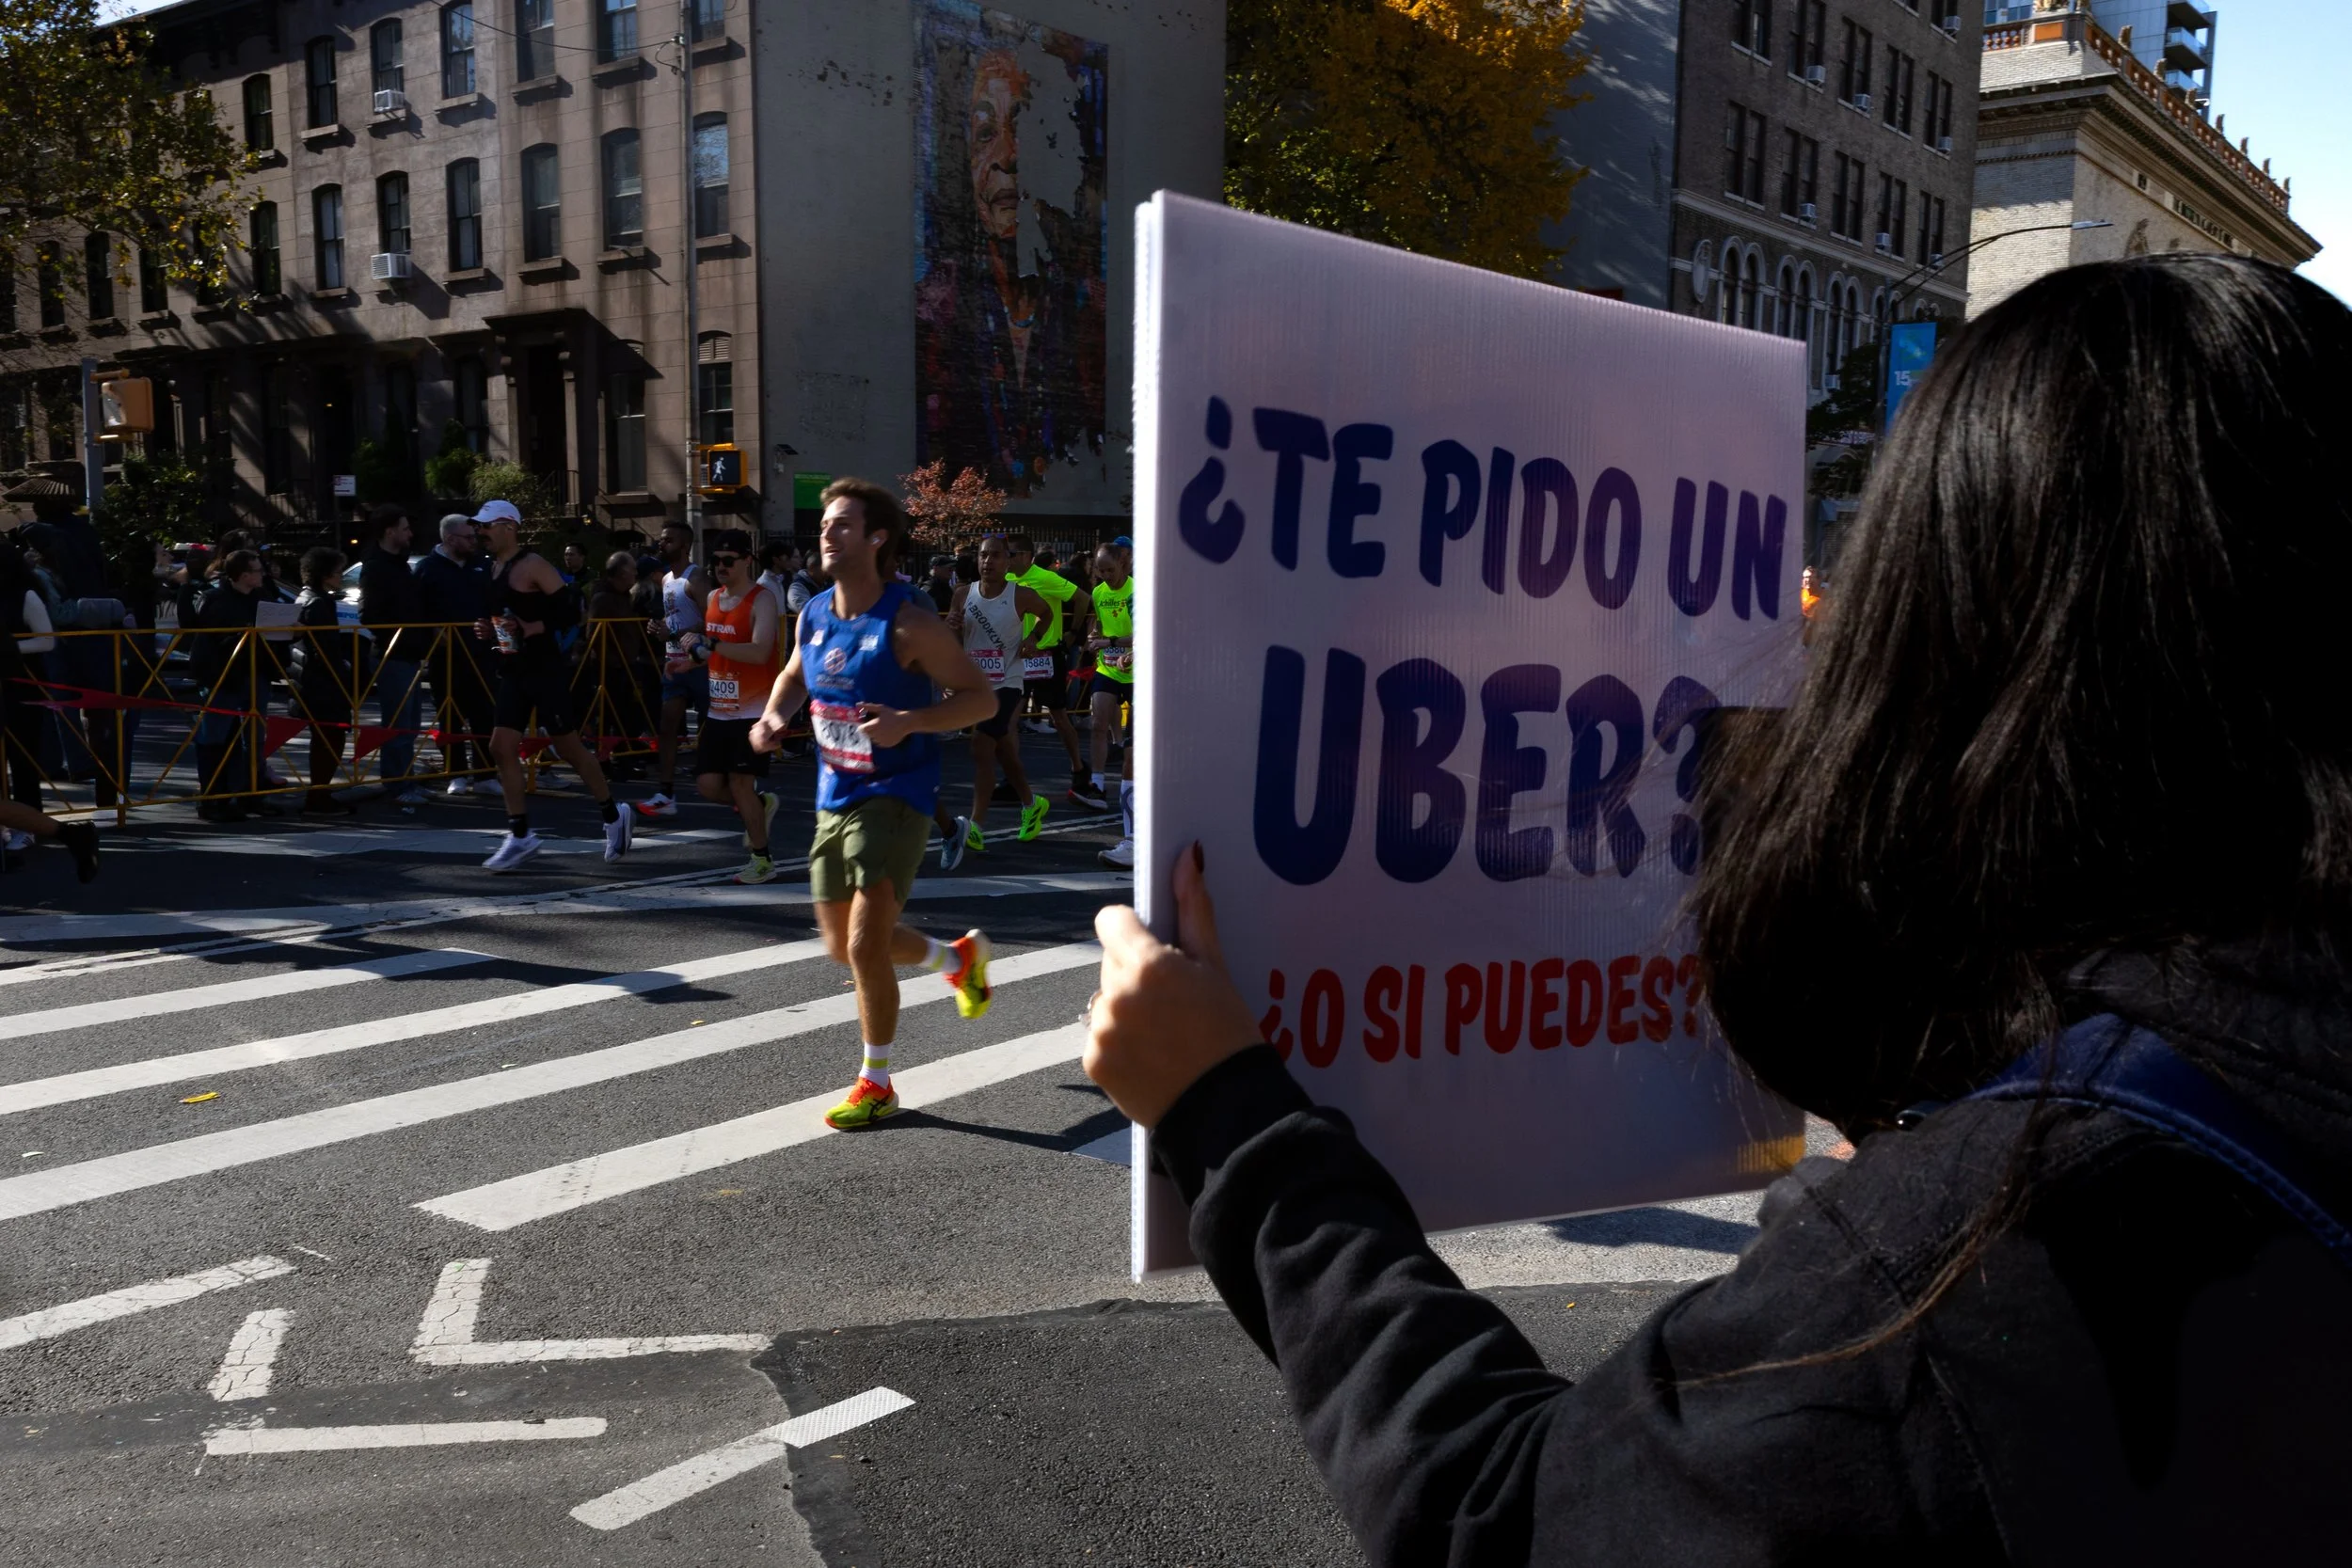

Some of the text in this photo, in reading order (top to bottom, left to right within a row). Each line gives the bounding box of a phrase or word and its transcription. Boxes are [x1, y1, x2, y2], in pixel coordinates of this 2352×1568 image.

[1178, 395, 1788, 622] ¿TE PIDO UN
[707, 622, 737, 636] STRAVA
[968, 605, 1007, 650] BROOKLYN
[1024, 658, 1051, 669] 15884
[1252, 644, 1721, 886] UBER?
[1260, 954, 1701, 1069] ¿O SI PUEDES?
